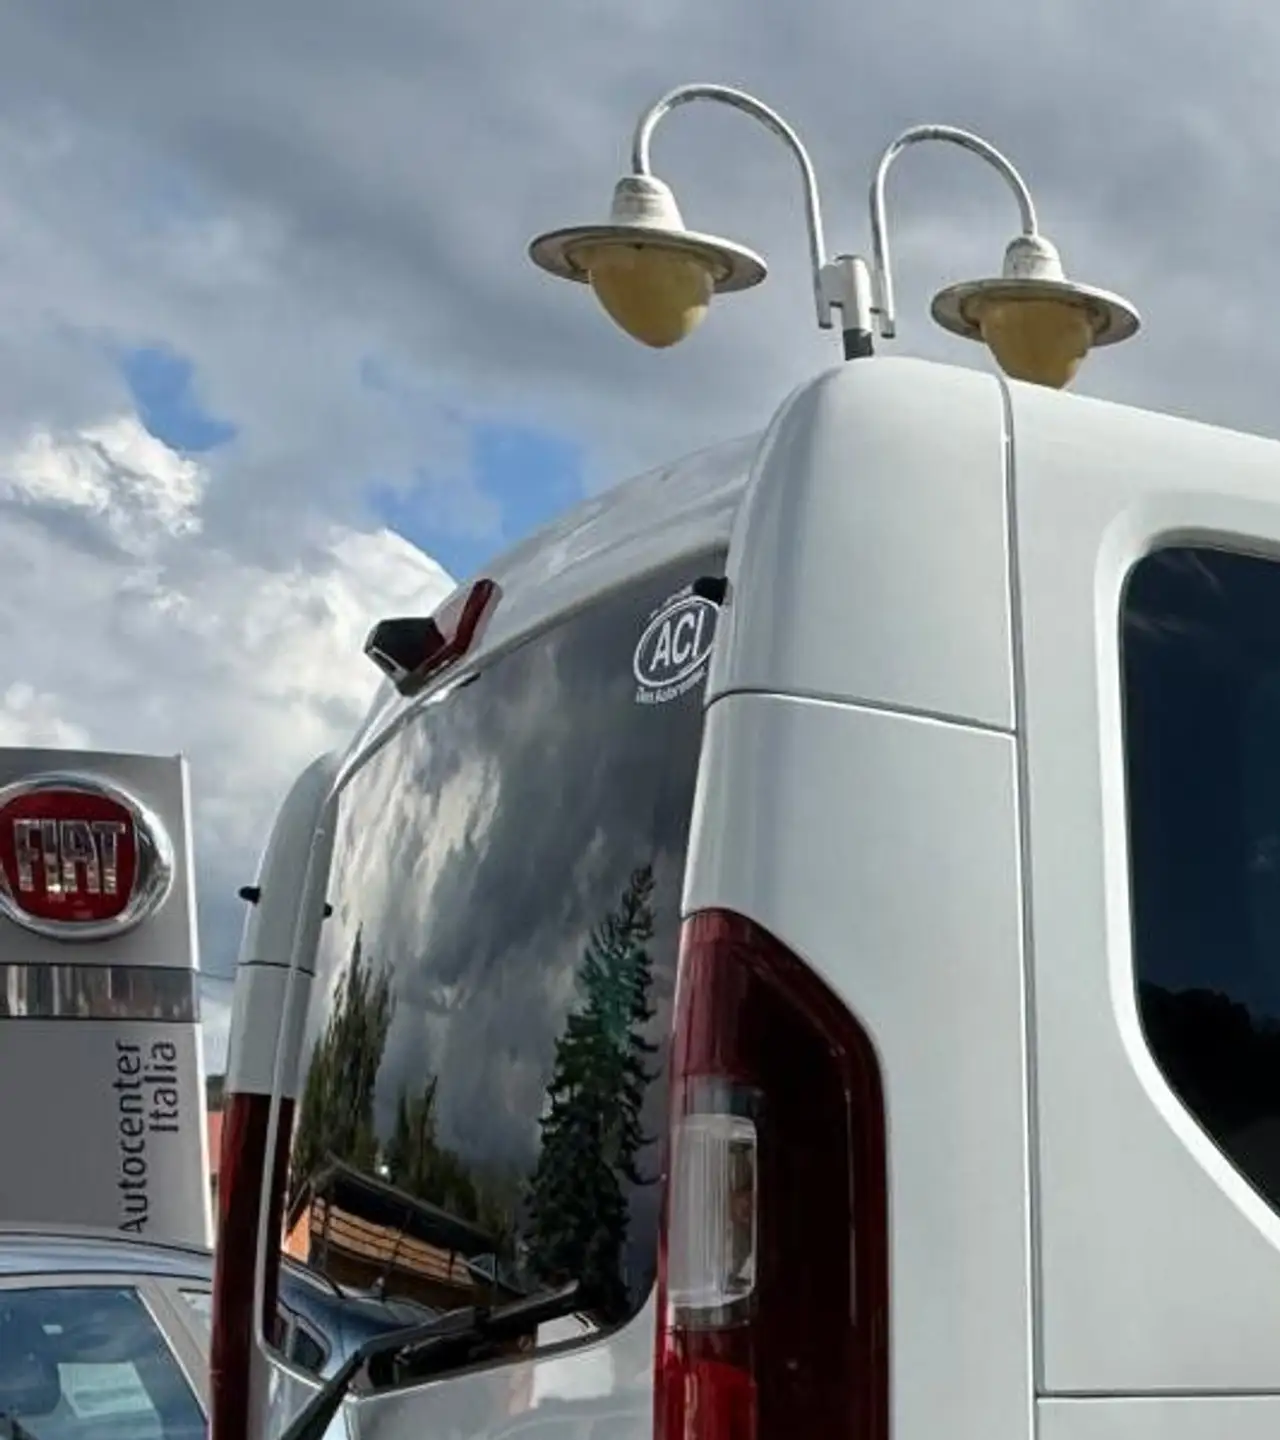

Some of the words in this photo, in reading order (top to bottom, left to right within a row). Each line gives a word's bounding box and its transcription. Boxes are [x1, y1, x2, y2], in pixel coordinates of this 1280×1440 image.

[649, 608, 705, 671] ACI
[13, 817, 126, 895] FIAT
[144, 1040, 180, 1133] Italia
[114, 1040, 149, 1235] Autocenter
